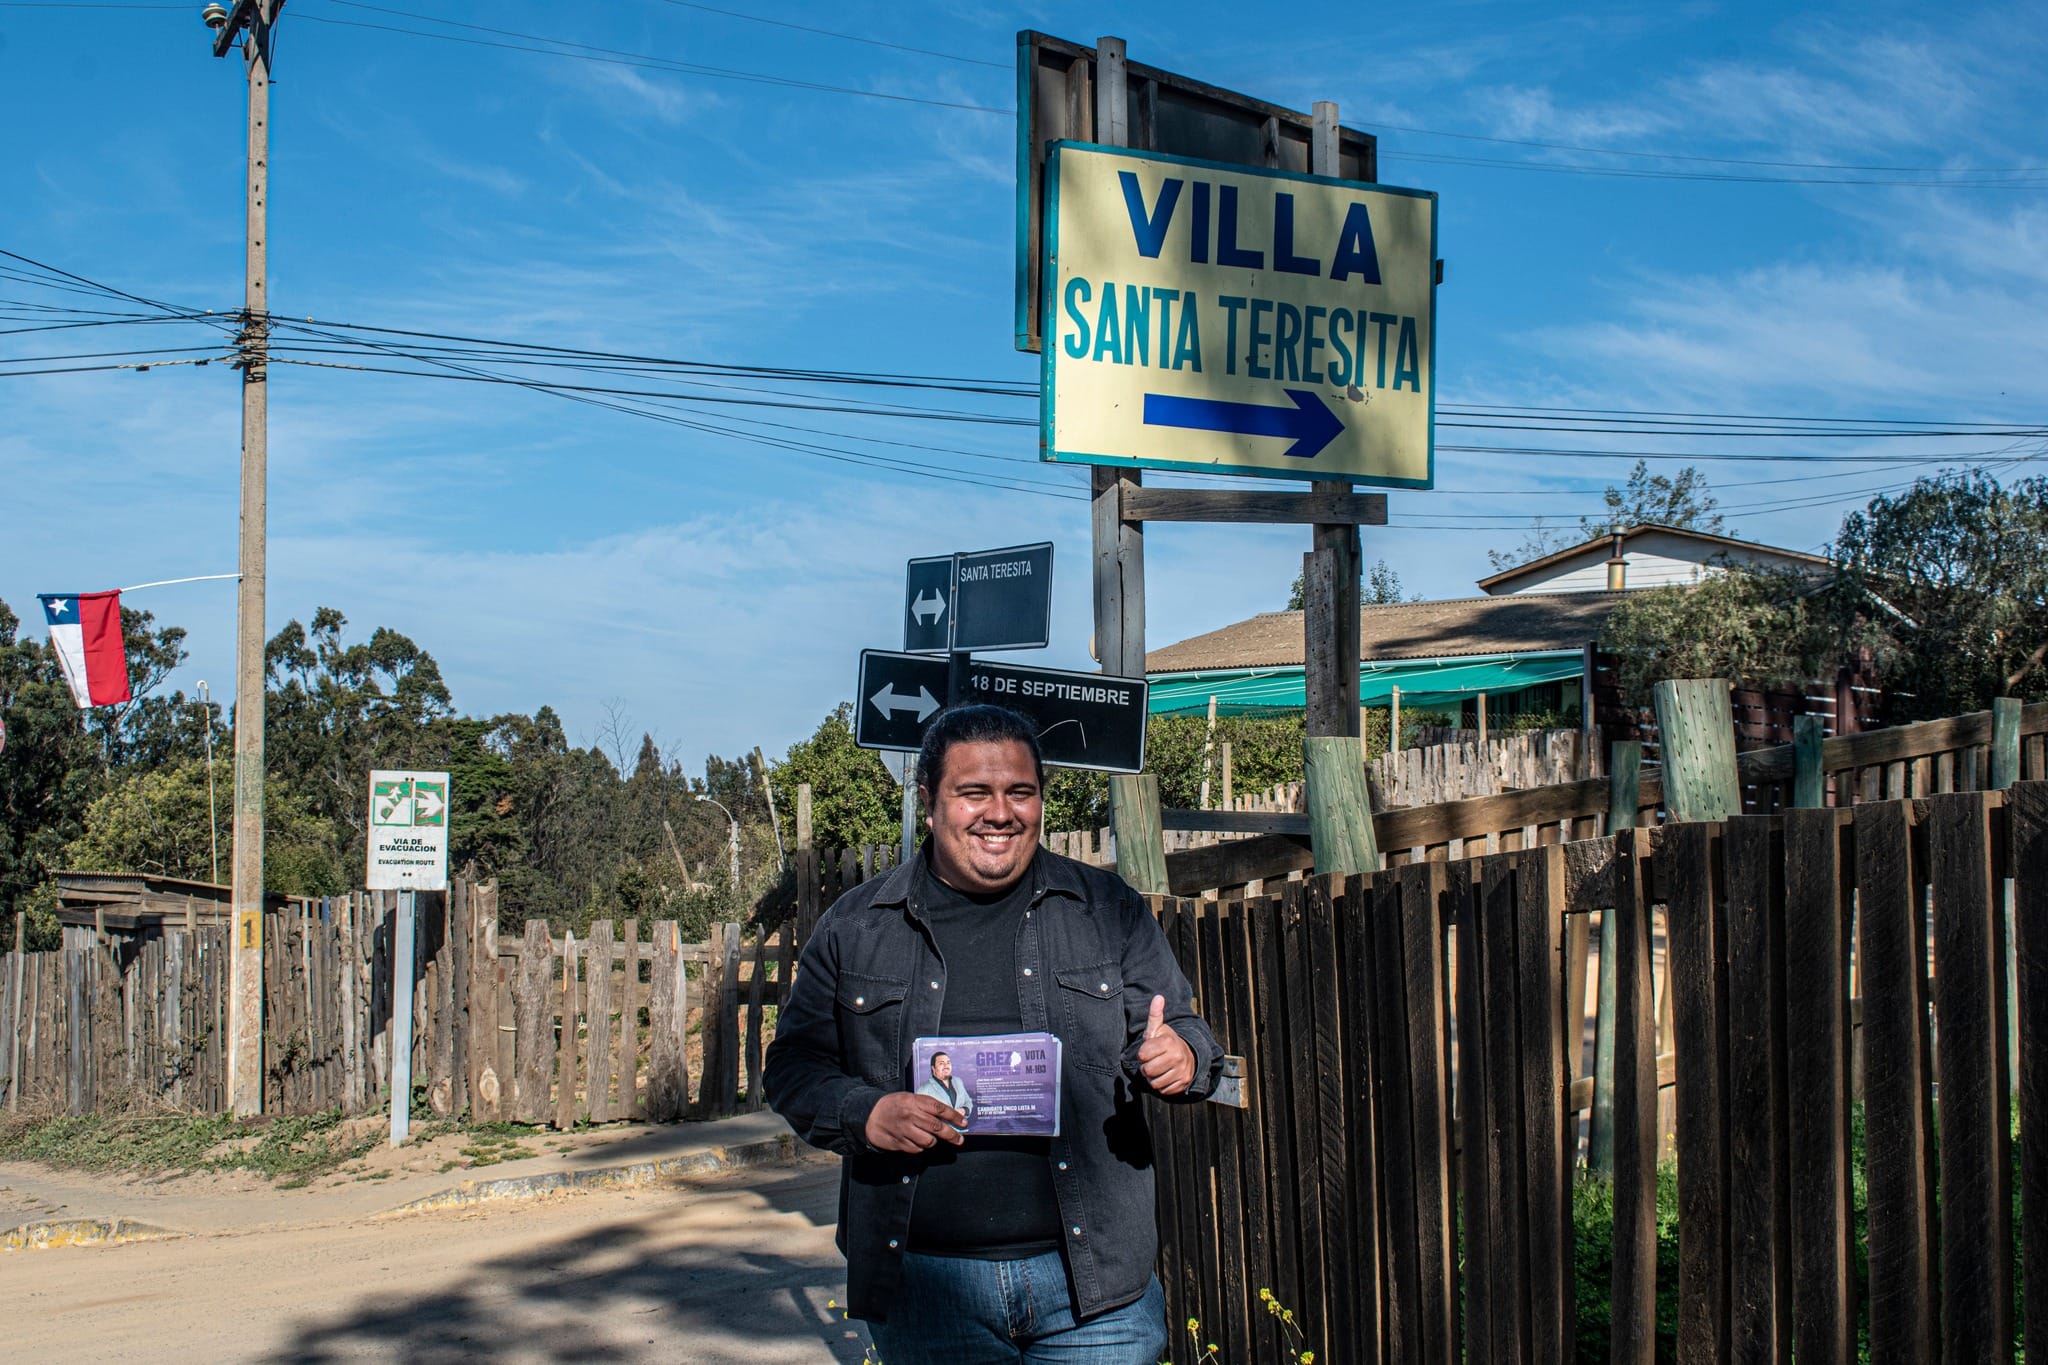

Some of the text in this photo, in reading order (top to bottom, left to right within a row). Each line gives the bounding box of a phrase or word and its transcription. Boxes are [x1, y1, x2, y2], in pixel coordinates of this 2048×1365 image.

[1118, 170, 1382, 285] VILLA
[1063, 277, 1421, 393] SANTA TERESITA
[960, 560, 1032, 582] SANTA TERESITA
[970, 674, 1130, 706] 18 DE SEPTIEMBRE
[243, 919, 252, 948] 1
[976, 1051, 1012, 1066] GREZ
[1025, 1050, 1046, 1060] VOTA
[1025, 1064, 1047, 1074] M-103
